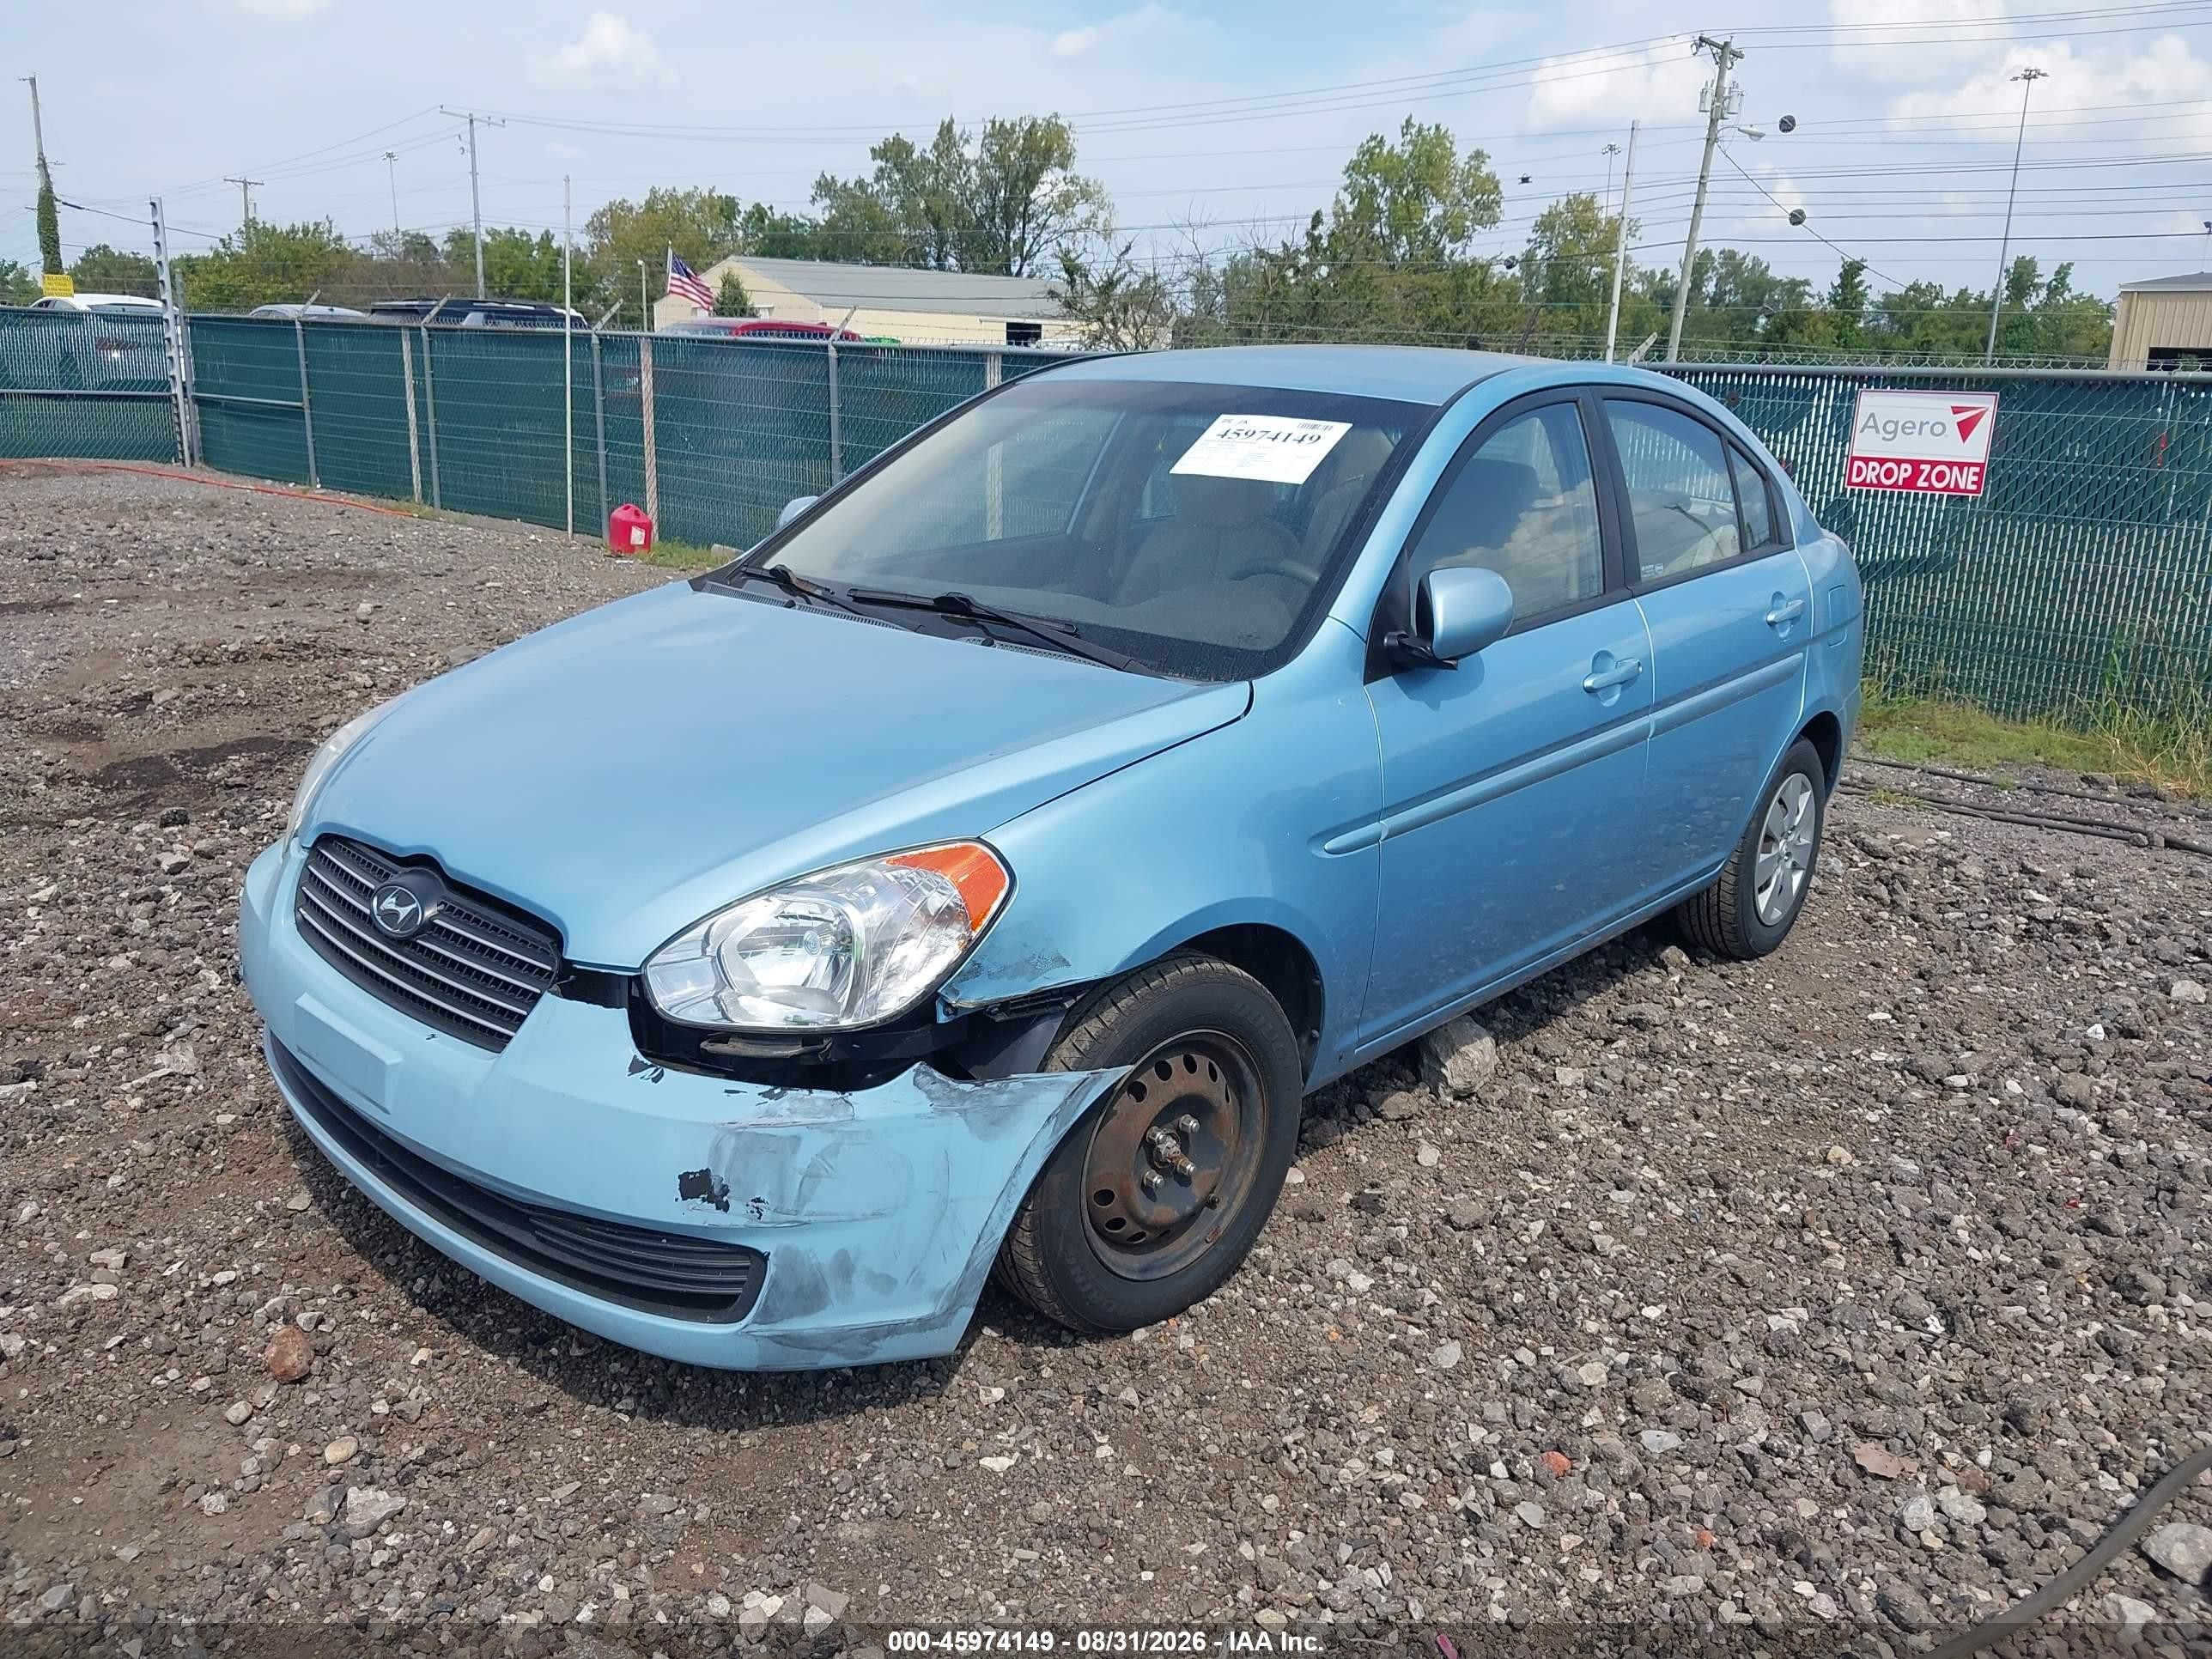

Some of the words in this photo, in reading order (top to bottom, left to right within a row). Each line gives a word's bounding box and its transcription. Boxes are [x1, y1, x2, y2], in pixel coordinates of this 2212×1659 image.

[1216, 428, 1322, 445] 45974149
[1859, 412, 1947, 442] Agero
[1851, 460, 1912, 486] DROP
[1917, 464, 1980, 490] ZONE
